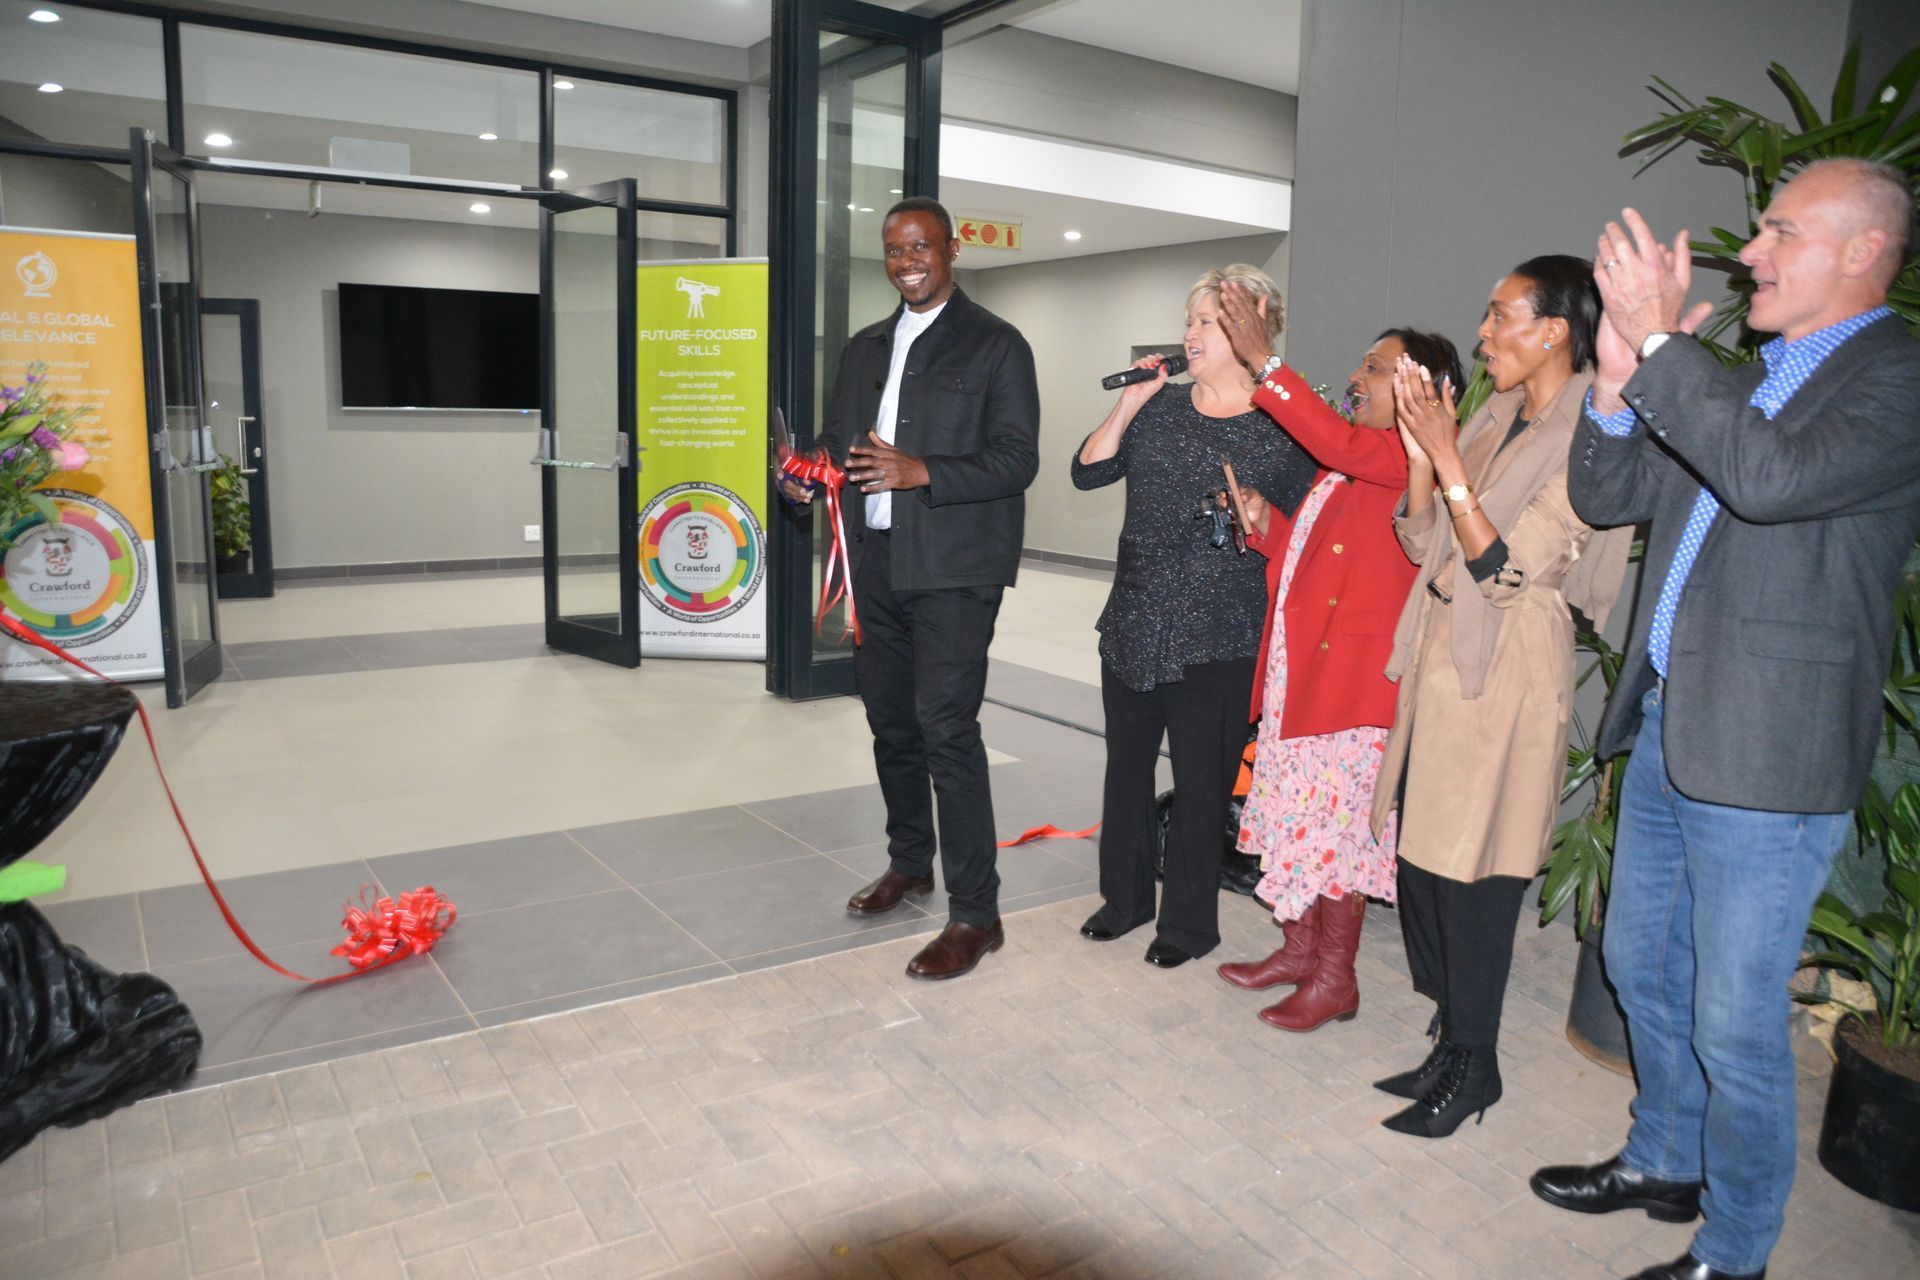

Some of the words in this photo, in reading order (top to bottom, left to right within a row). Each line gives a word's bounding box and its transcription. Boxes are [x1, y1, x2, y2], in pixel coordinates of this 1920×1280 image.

[28, 312, 40, 324] &
[44, 312, 115, 328] GLOBAL
[640, 328, 758, 341] FUTURE-FOCUSED
[677, 345, 721, 356] SKILLS
[660, 393, 719, 403] understandings
[706, 483, 725, 494] World
[730, 493, 760, 528] Opportunities
[674, 562, 721, 573] Crawford
[29, 580, 91, 593] Crawford
